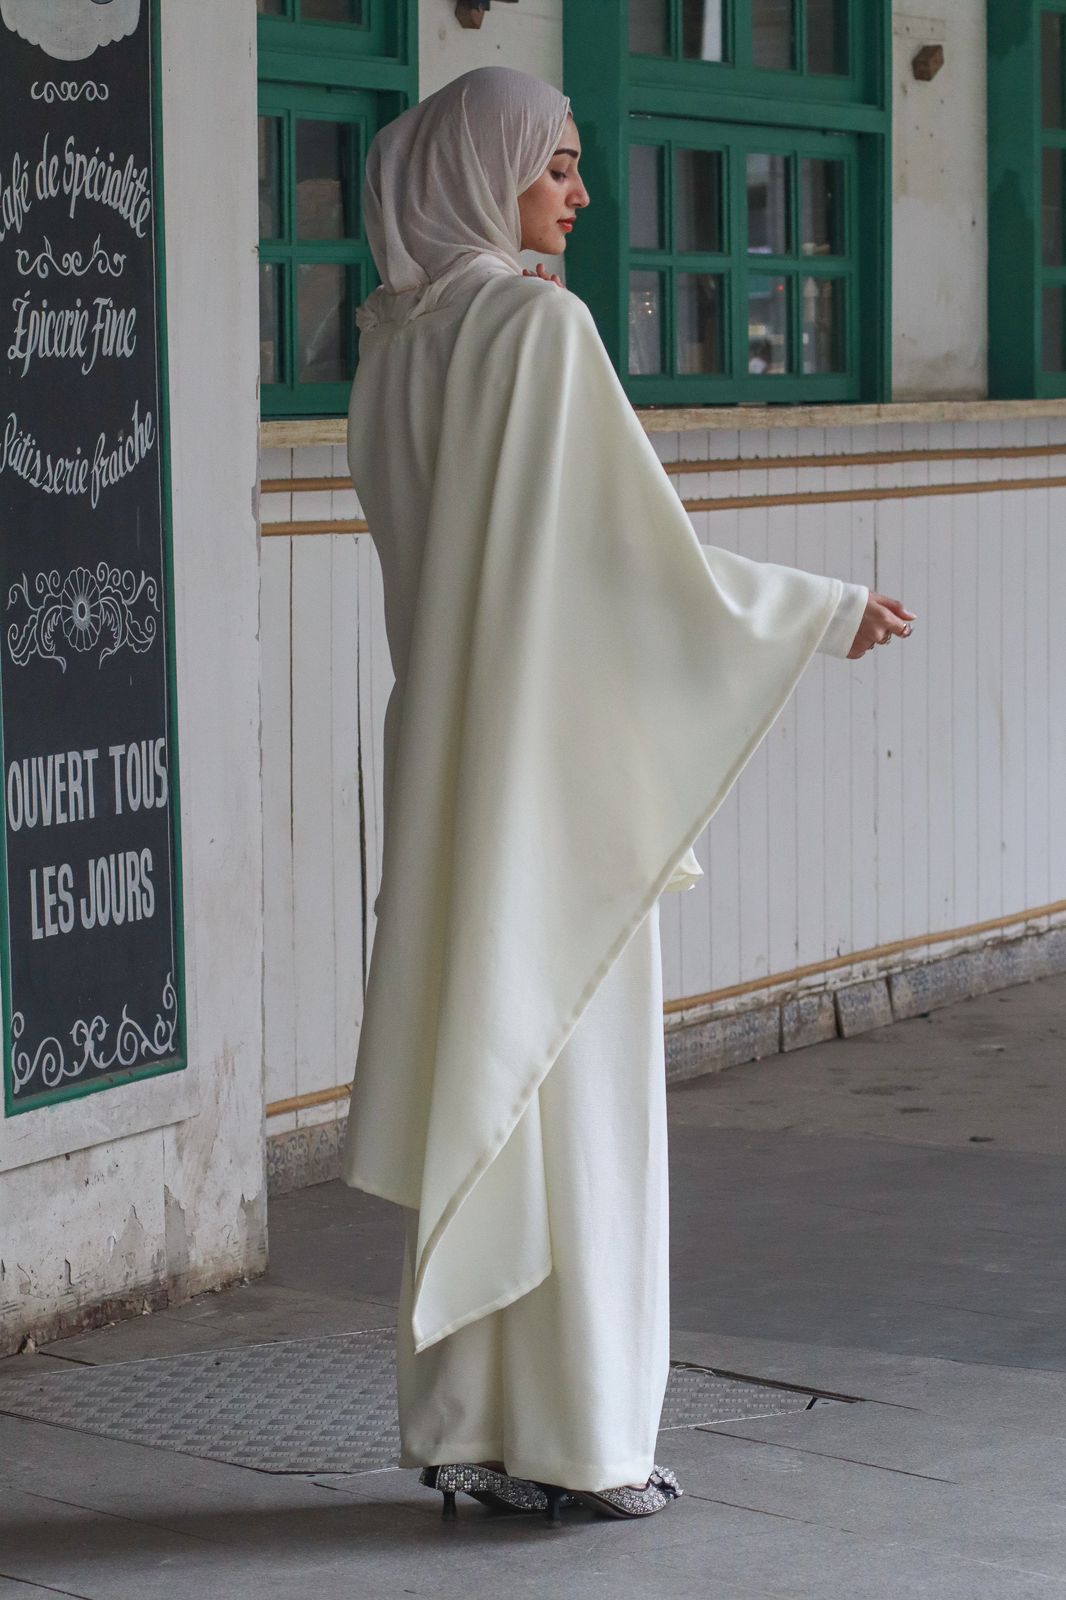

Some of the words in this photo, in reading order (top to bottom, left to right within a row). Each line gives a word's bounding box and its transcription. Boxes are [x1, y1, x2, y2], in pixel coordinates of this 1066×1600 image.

[0, 152, 32, 240] afé
[36, 132, 60, 201] de
[62, 135, 151, 238] Spécialité
[7, 290, 88, 378] Épicerie
[81, 297, 137, 376] Fine
[7, 749, 99, 832] OUVERT
[109, 738, 168, 814] TOUS
[30, 864, 74, 940] LES
[80, 848, 155, 930] JOURS
